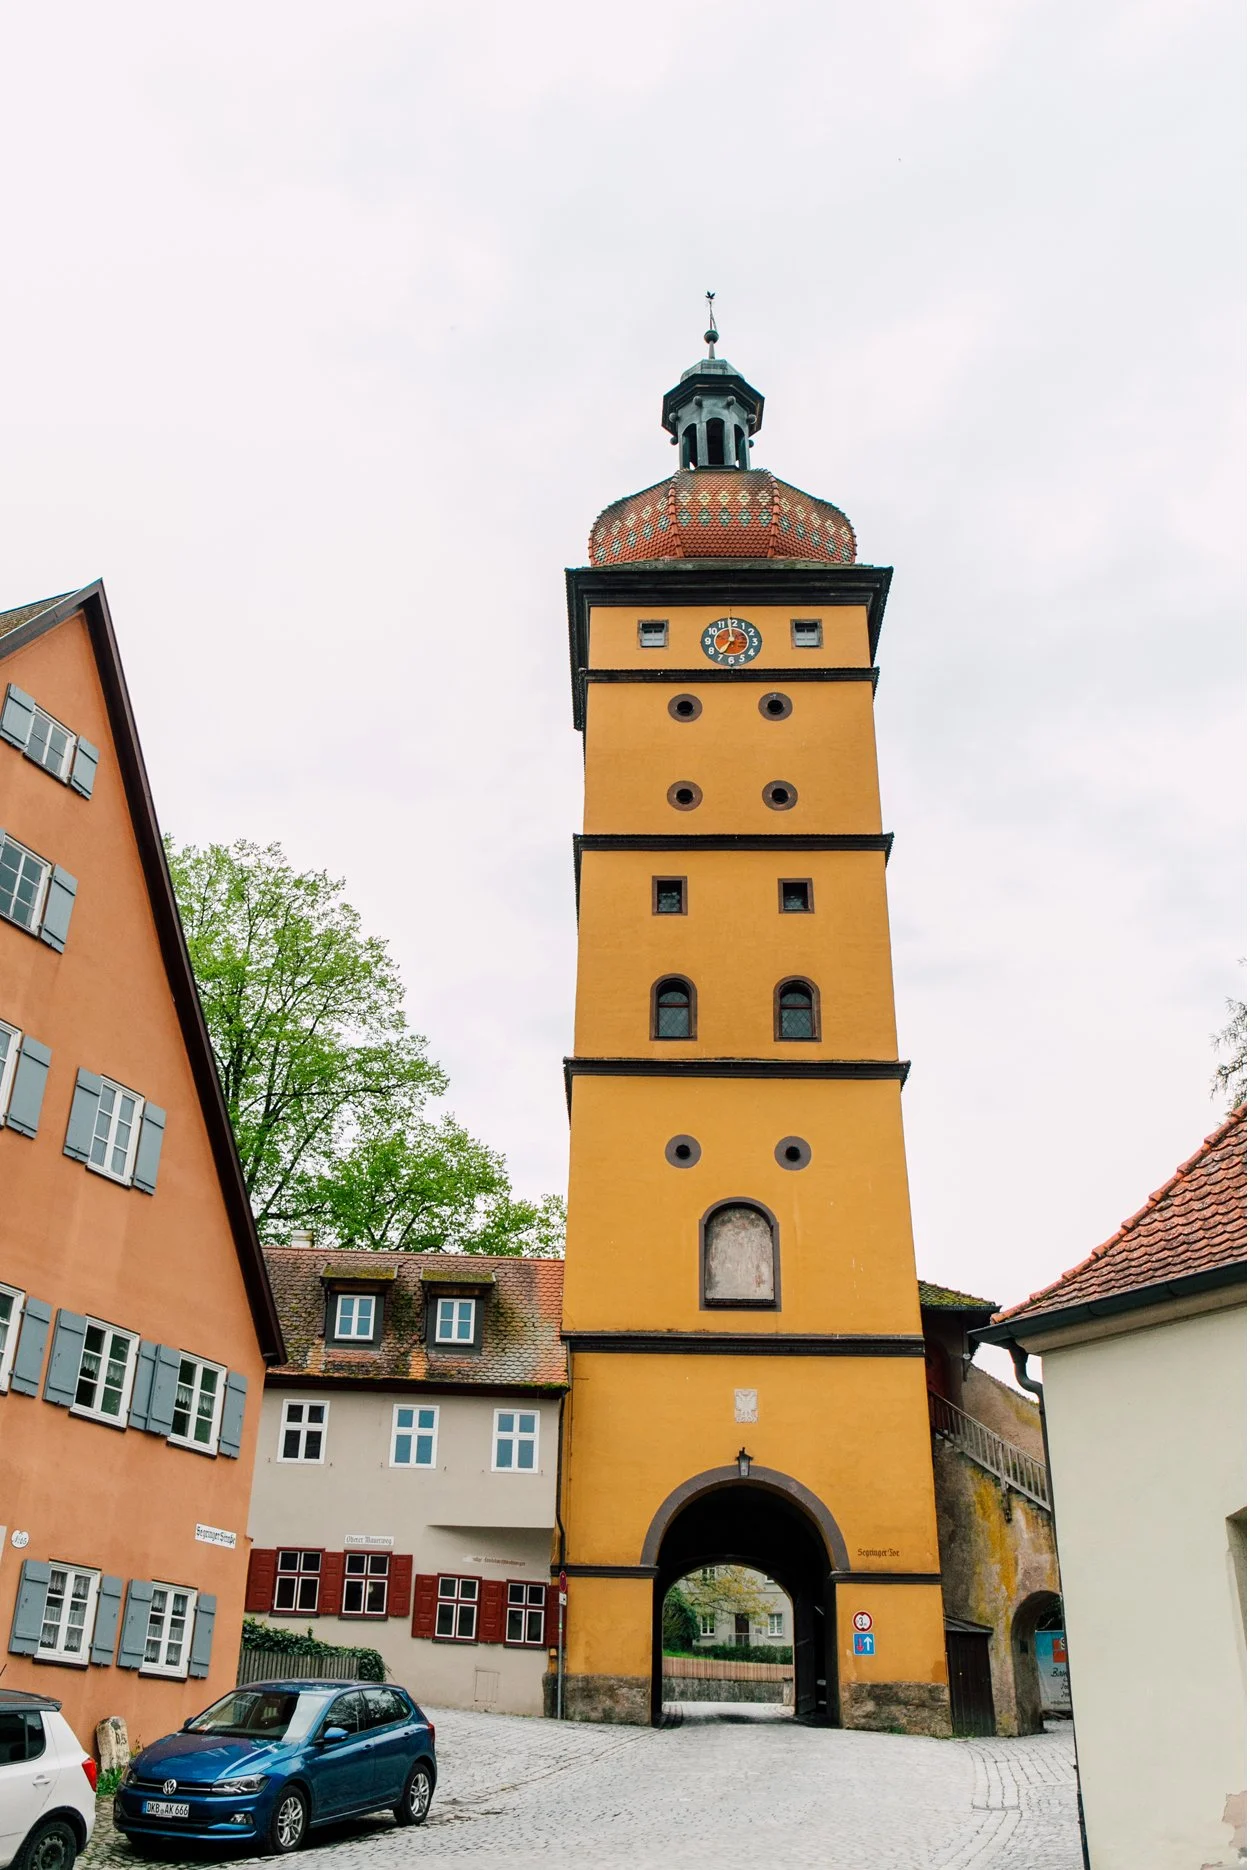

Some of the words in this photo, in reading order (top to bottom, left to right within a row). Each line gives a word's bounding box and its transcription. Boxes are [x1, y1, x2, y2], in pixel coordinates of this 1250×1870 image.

[741, 622, 745, 630] 1
[708, 627, 718, 635] 10
[748, 628, 755, 636] 2
[704, 637, 711, 645] 9
[751, 638, 758, 646] 3
[708, 647, 714, 655] 8
[748, 648, 755, 656] 4
[728, 656, 735, 664] 6
[739, 654, 745, 662] 5
[147, 1802, 160, 1814] DKB
[164, 1803, 174, 1815] AK
[174, 1804, 189, 1816] 666
